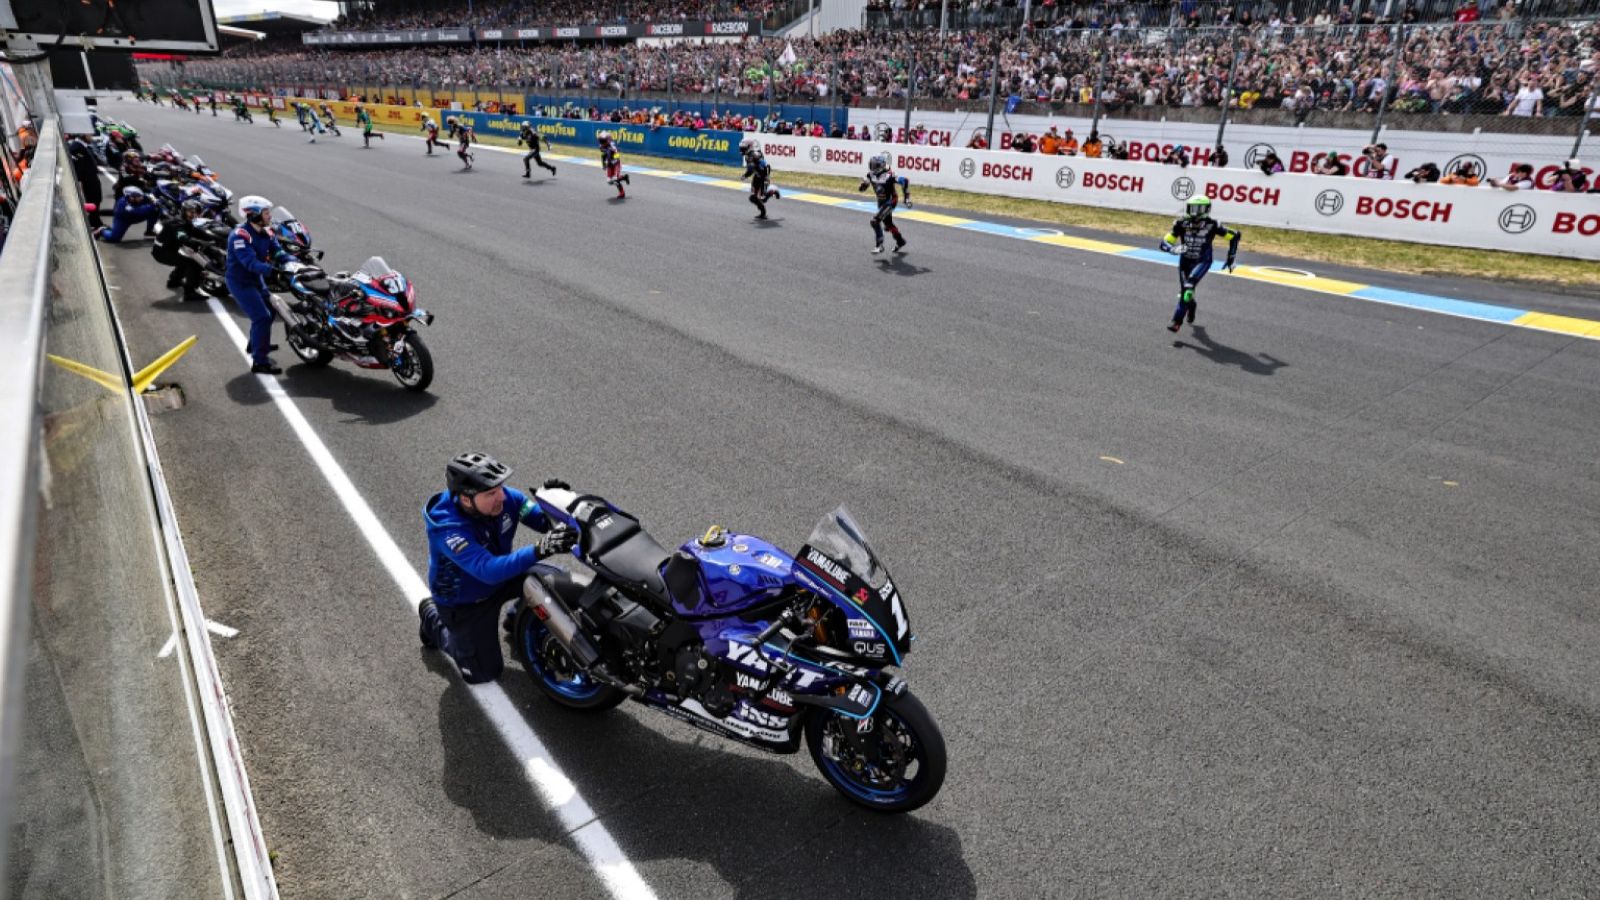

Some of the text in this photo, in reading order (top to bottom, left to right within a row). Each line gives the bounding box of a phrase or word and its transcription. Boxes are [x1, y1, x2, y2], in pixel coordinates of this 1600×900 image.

[651, 24, 683, 34] RACEBORN
[712, 22, 748, 33] RACEBORN
[669, 134, 729, 152] GOODYEAR
[896, 128, 950, 146] BOCH
[765, 144, 796, 157] BOSCH
[826, 149, 863, 164] BOSCH
[897, 156, 940, 172] BOSCH
[982, 163, 1033, 181] BOSCH
[1082, 172, 1144, 193] BOSCH
[1205, 183, 1280, 206] BOSCH
[1356, 196, 1453, 222] BOSCH
[807, 547, 851, 584] YAMALUBE
[891, 592, 908, 640] 1
[854, 641, 885, 654] QUS
